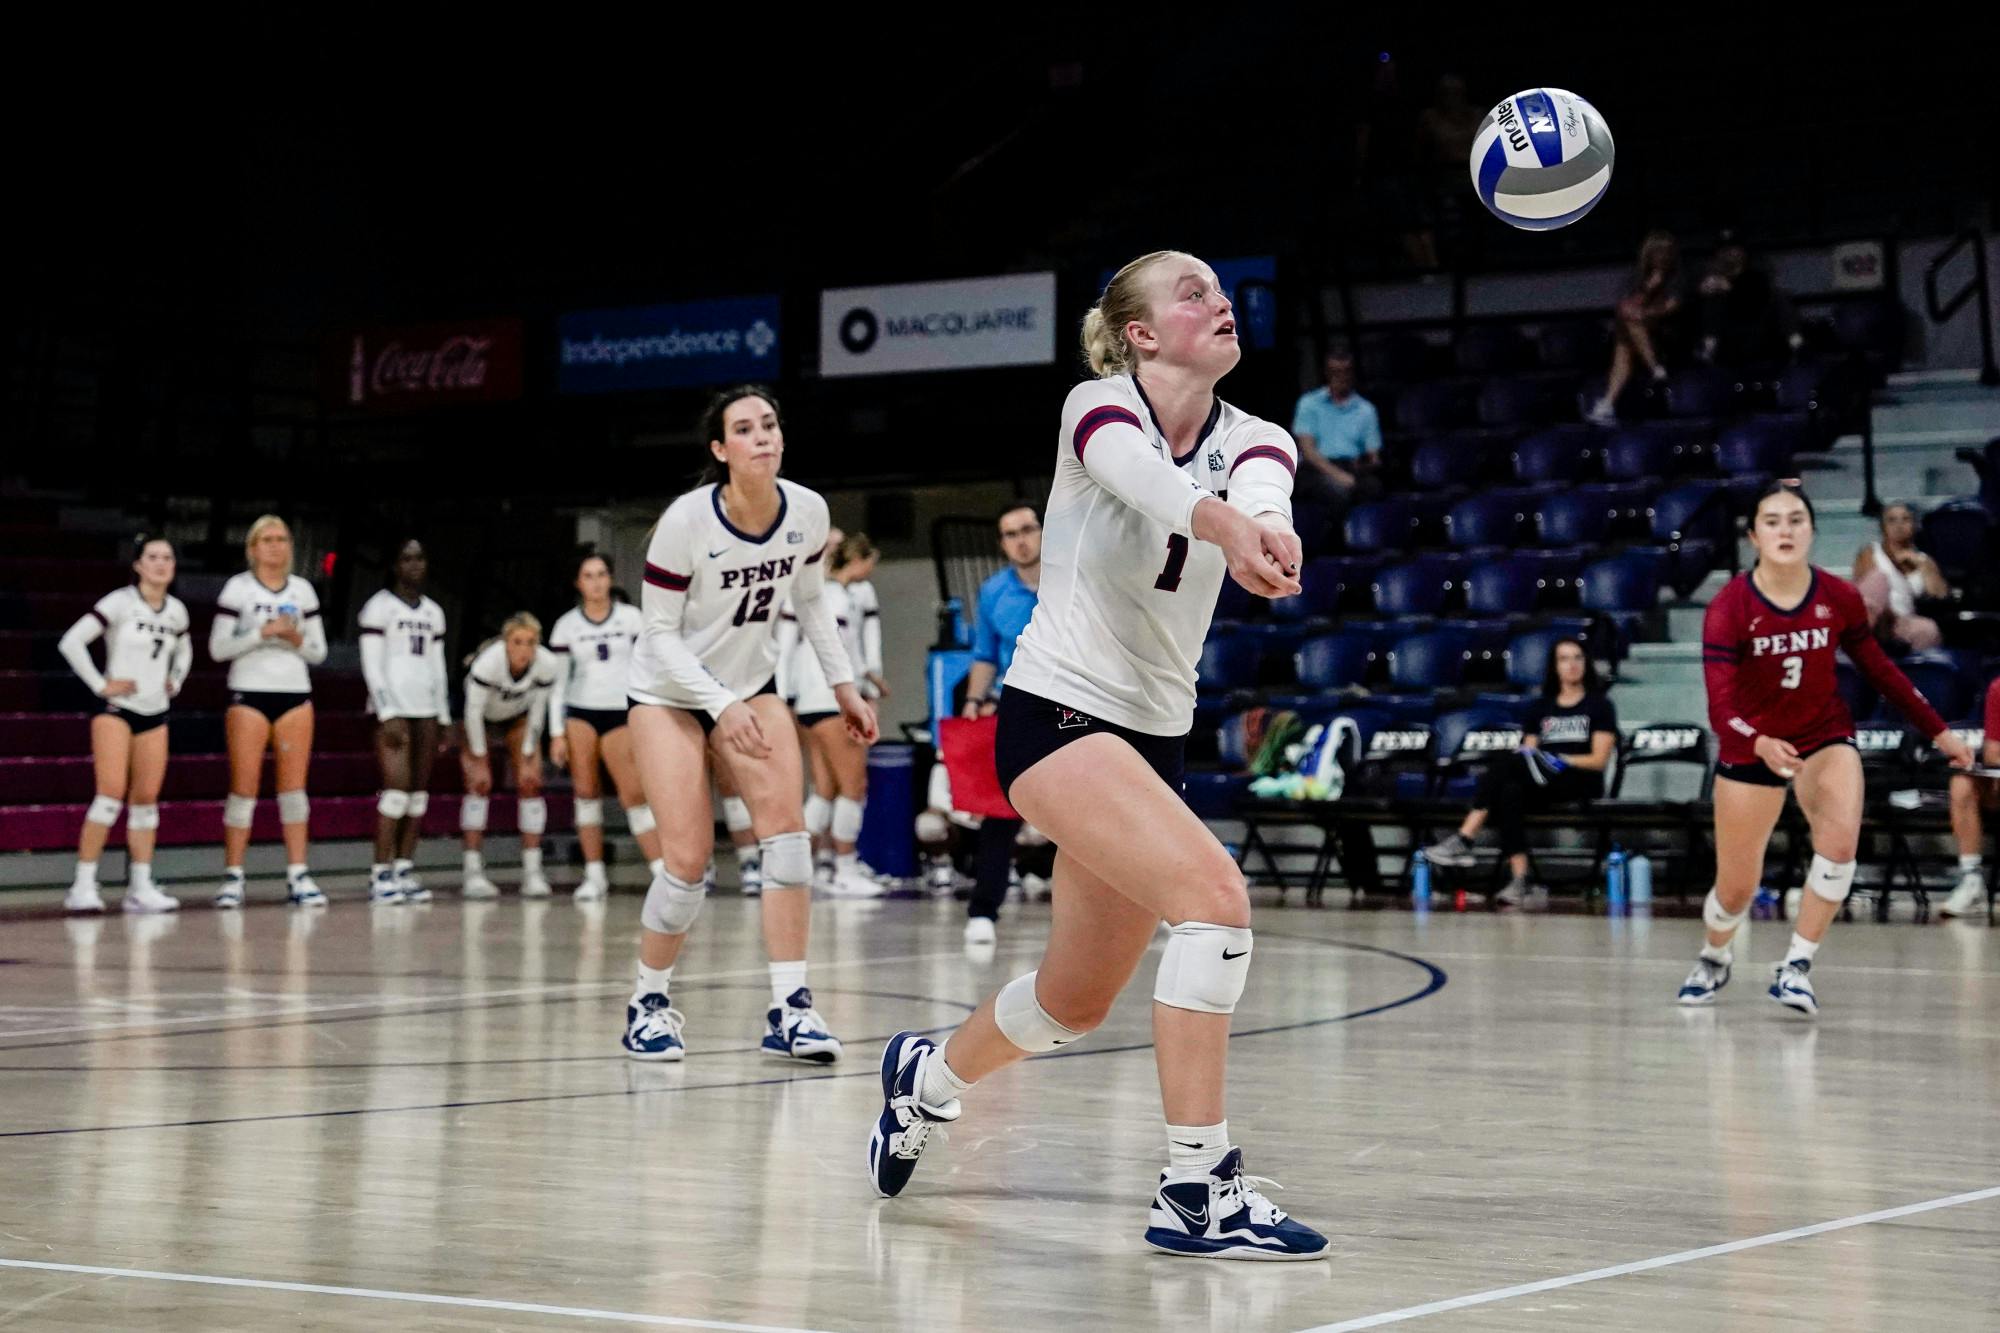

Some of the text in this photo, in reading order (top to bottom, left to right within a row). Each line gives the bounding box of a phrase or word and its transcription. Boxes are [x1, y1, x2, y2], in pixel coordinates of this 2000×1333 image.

[886, 306, 1037, 337] MACQUARIE
[561, 329, 740, 368] Independence
[1154, 532, 1189, 593] 1
[732, 586, 775, 627] 12
[151, 638, 164, 659] 7
[1752, 627, 1830, 657] PENN
[1780, 656, 1803, 690] 3
[1369, 730, 1431, 751] PENN
[1462, 730, 1523, 751] PENN
[1633, 728, 1701, 750] PENN
[1855, 729, 1904, 750] ENN
